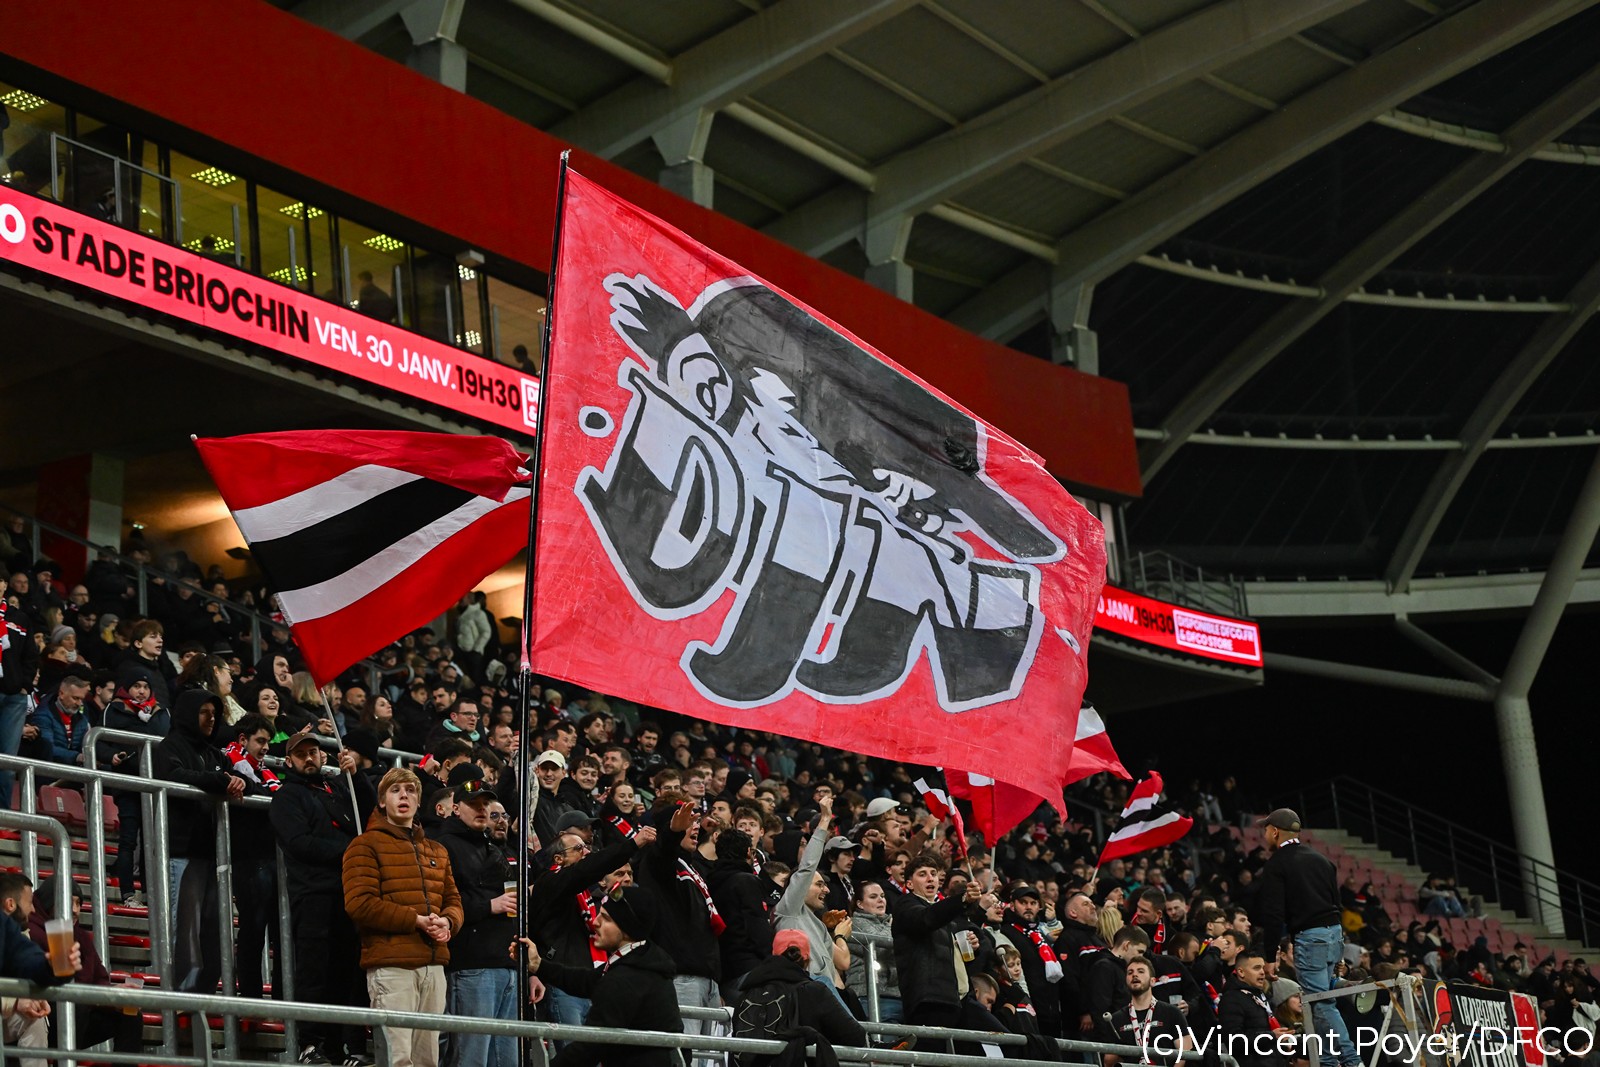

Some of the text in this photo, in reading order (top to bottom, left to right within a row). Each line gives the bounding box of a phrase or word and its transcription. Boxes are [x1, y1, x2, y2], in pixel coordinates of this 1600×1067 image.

[32, 216, 146, 288] STADE
[152, 257, 309, 343] BRIOCHIN
[314, 316, 362, 357] VEN.
[366, 335, 393, 367] 30
[398, 348, 456, 389] JANV.
[456, 365, 520, 411] 19H30
[1106, 598, 1138, 625] JANV.
[1137, 606, 1175, 634] 19H30
